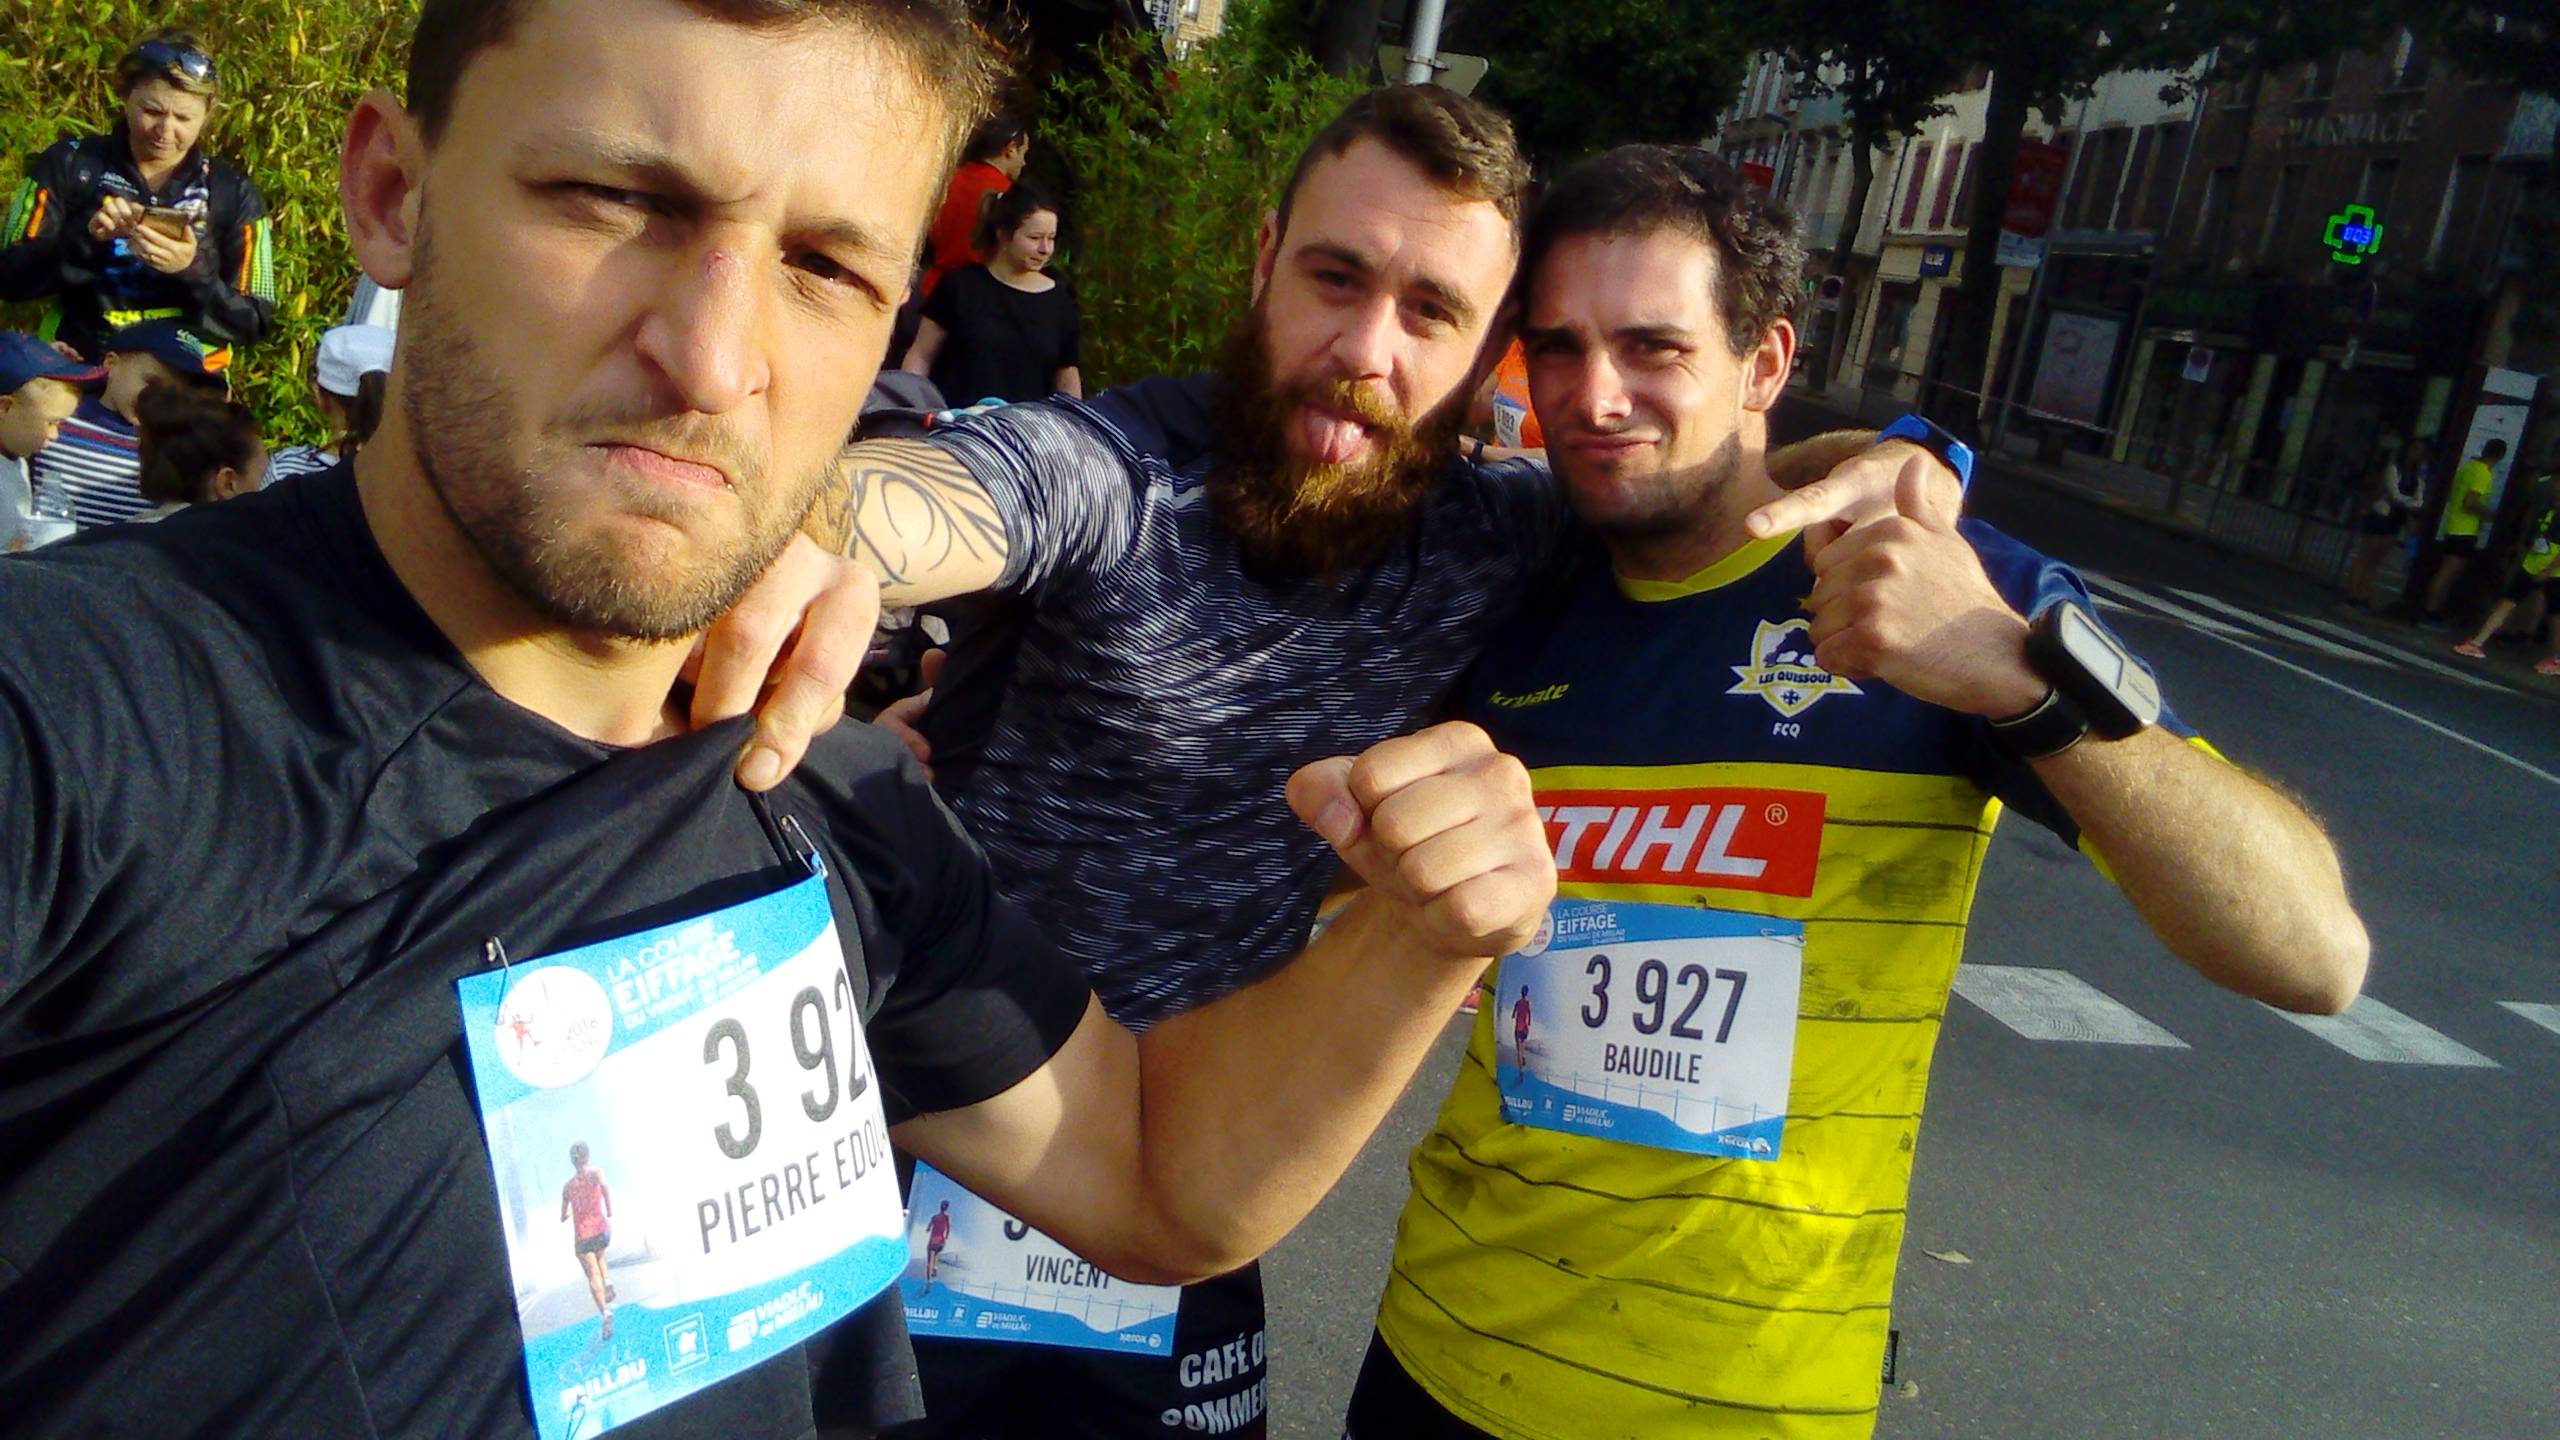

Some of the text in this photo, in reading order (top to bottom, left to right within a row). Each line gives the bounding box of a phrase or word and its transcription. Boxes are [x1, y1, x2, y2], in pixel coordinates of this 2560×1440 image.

[1759, 672, 1776, 684] LES
[1772, 722, 1801, 739] FCQ
[1541, 804, 1768, 878] TIHL
[1557, 913, 1617, 935] EIFFAGE
[605, 956, 637, 983] LA
[612, 929, 741, 1015] EIFFAGE
[1581, 954, 1748, 1044] 3 927
[703, 967, 873, 1160] 3 92
[1603, 1042, 1703, 1085] BAUDILE
[697, 1108, 888, 1255] PIERRE EDOU
[1179, 1332, 1250, 1388] CAFÉ
